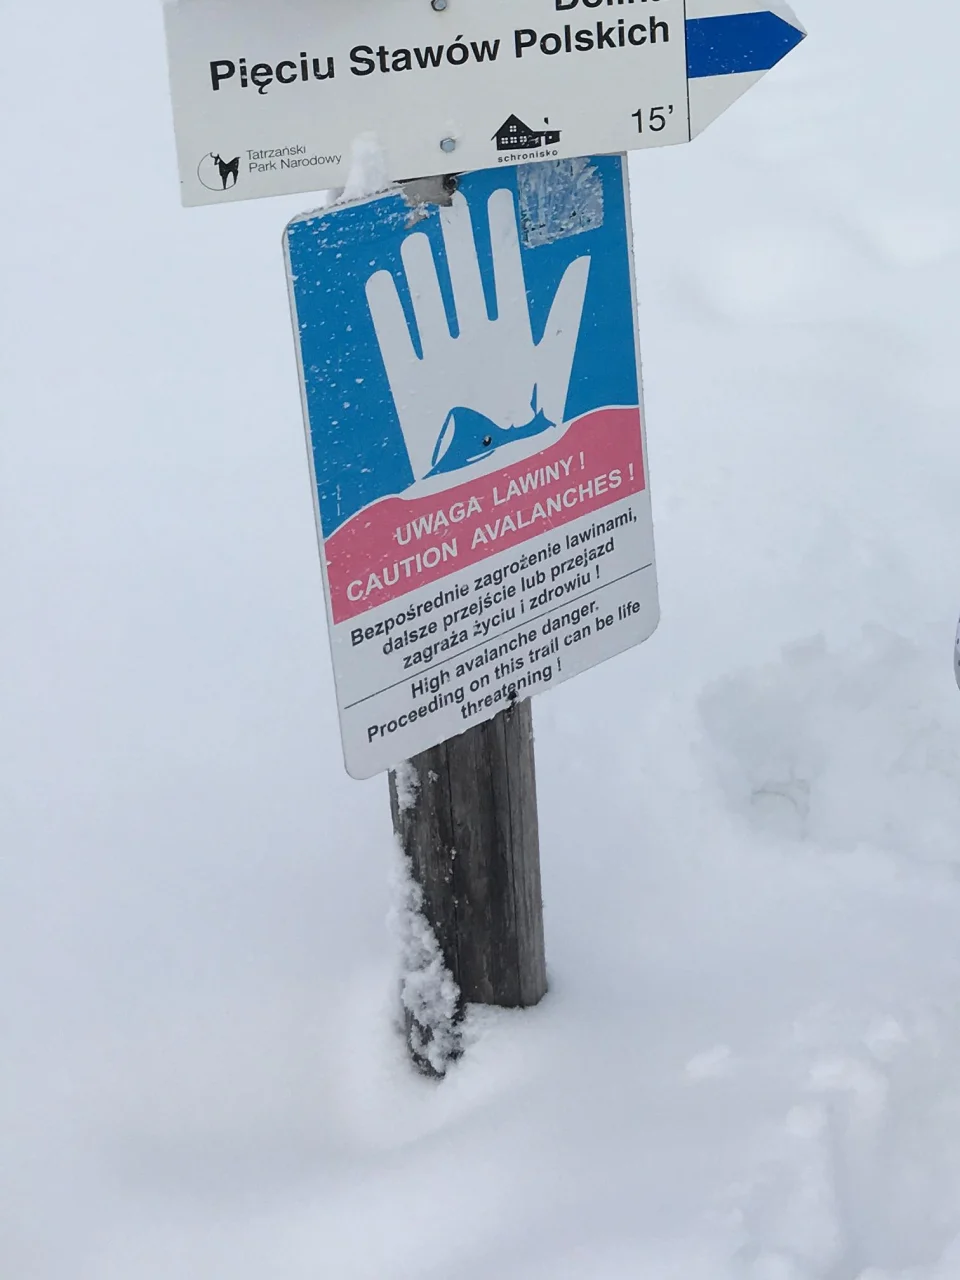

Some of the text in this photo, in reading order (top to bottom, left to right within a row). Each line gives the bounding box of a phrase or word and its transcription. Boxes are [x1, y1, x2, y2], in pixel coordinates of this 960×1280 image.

[209, 15, 670, 95] Pięciu Stawów Polskich
[246, 144, 307, 161] Tatrzański
[249, 153, 342, 173] Park Narodowy
[497, 149, 559, 163] schronisko
[346, 538, 459, 602] CAUTION
[470, 470, 624, 550] AVALANCHES
[395, 495, 482, 546] UWAGA
[492, 456, 573, 506] LAWINY
[351, 507, 638, 646] Bezpośrednie zagrożenie lawinami,
[383, 537, 615, 656] dalsze przejście lub przejazd
[403, 631, 469, 669] zagraża
[473, 607, 516, 637] życiu
[520, 599, 525, 614] i
[529, 572, 592, 610] zdrowiu
[366, 600, 642, 743] Proceeding on this trail can be life
[411, 600, 600, 699] High avalanche danger.
[461, 664, 554, 720] threatening
